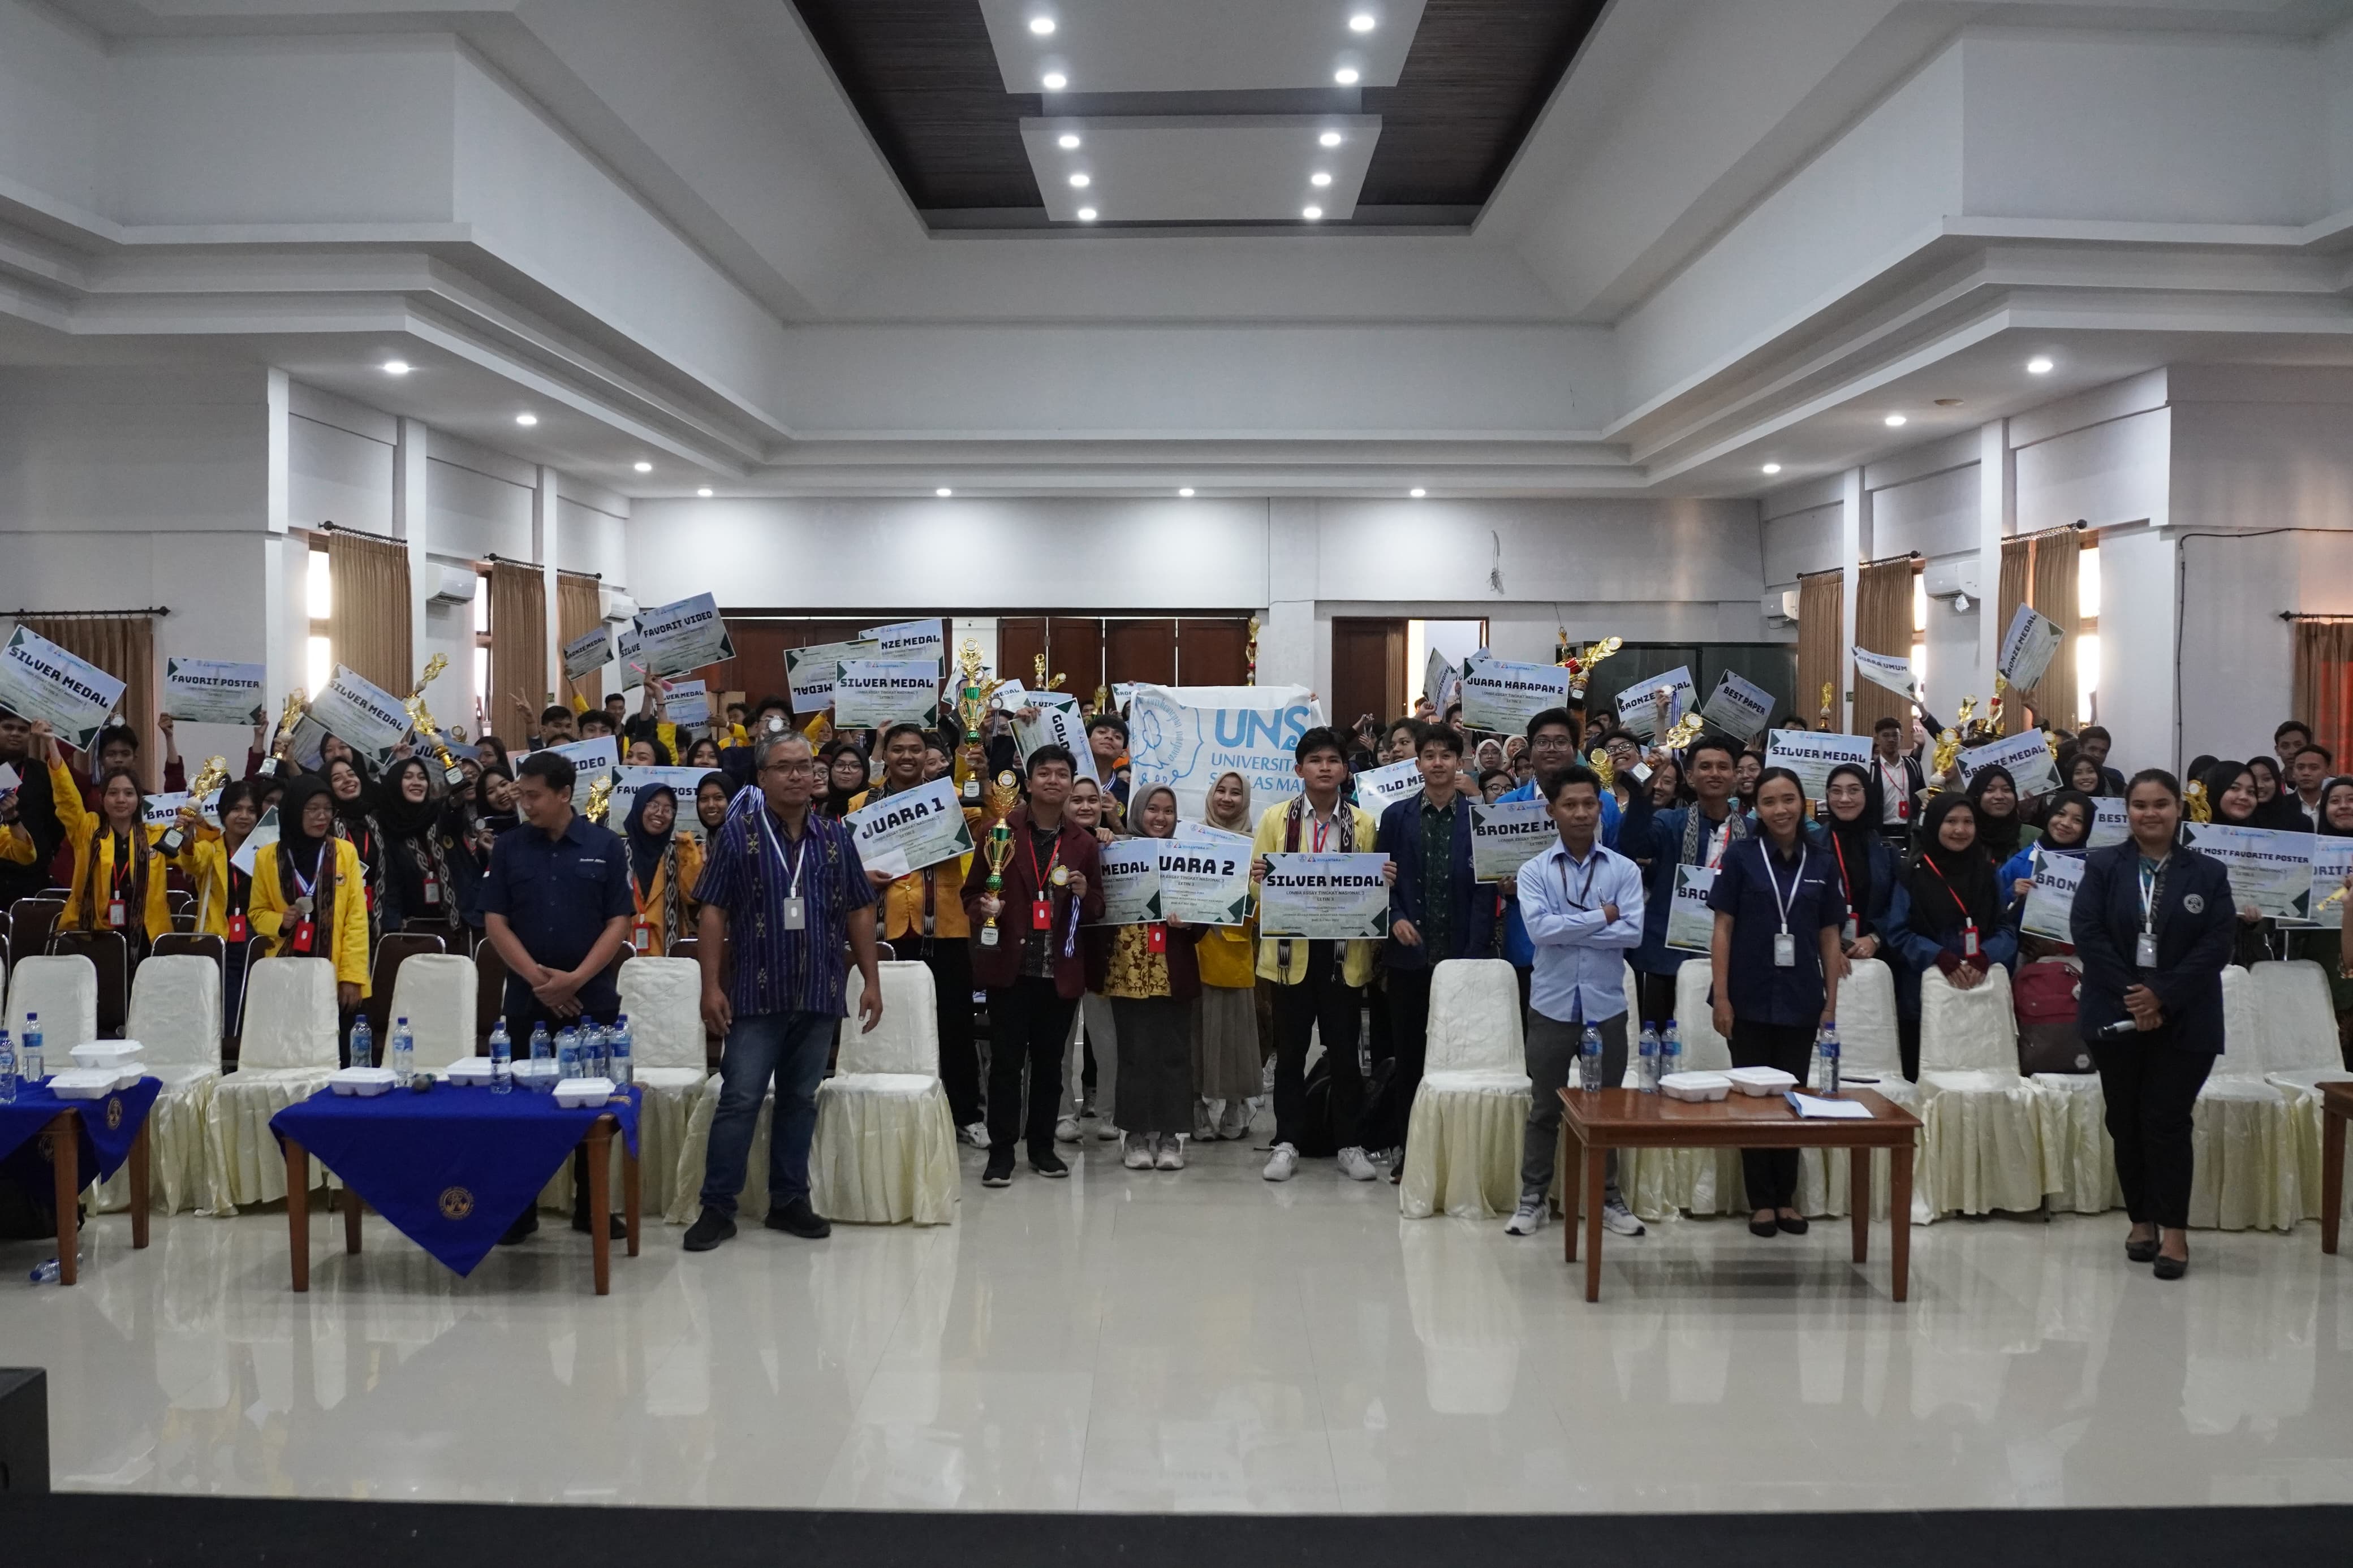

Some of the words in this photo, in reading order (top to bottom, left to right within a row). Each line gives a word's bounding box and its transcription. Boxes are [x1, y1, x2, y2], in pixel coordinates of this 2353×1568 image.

[644, 620, 682, 638] FAVORIT
[684, 611, 713, 625] VIDEO
[2018, 614, 2037, 644] MEDAL
[586, 637, 606, 648] MEDAL
[882, 640, 901, 650] NZE
[903, 635, 940, 646] MEDAL
[620, 643, 641, 658] SILVE
[1858, 656, 1882, 667] JUARA
[9, 647, 61, 681] SILVER
[62, 676, 108, 709] MEDAL
[172, 675, 218, 685] FAVORIT
[221, 679, 259, 688] POSTER
[841, 679, 887, 687] SILVER
[891, 679, 933, 688] MEDAL
[1467, 677, 1502, 688] JUARA
[1505, 681, 1555, 693] HARAPAN
[794, 683, 833, 696] MEDAL
[993, 689, 1020, 697] MEDAL
[1620, 693, 1655, 712] BRONZE
[1673, 681, 1690, 692] DAL
[329, 680, 367, 708] SILVER
[368, 705, 403, 731] MEDAL
[1723, 686, 1744, 701] BEST
[1743, 698, 1765, 715] PAPER
[1052, 714, 1070, 750] GOLD
[1215, 705, 1310, 751] UNS
[1772, 746, 1820, 758] SILVER
[1822, 751, 1865, 763] MEDAL
[2009, 745, 2046, 763] MEDAL
[570, 757, 606, 771] IDEO
[1212, 753, 1297, 772] UNIVERSIT
[672, 787, 698, 796] POST
[1370, 780, 1404, 795] OLD
[147, 808, 178, 820] BRO
[862, 802, 929, 839] JUARA
[932, 797, 945, 812] 1
[2098, 813, 2128, 823] BEST
[1476, 822, 1540, 836] BRONZE
[2229, 850, 2274, 860] FAVORITE
[2276, 855, 2309, 863] POSTER
[1101, 861, 1149, 876] MEDAL
[1159, 856, 1216, 874] UARA
[1222, 860, 1235, 875] 2
[1267, 875, 1327, 887] SILVER
[1331, 875, 1384, 887] MEDAL
[2035, 873, 2078, 892] BRON
[1678, 887, 1708, 901] BRO
